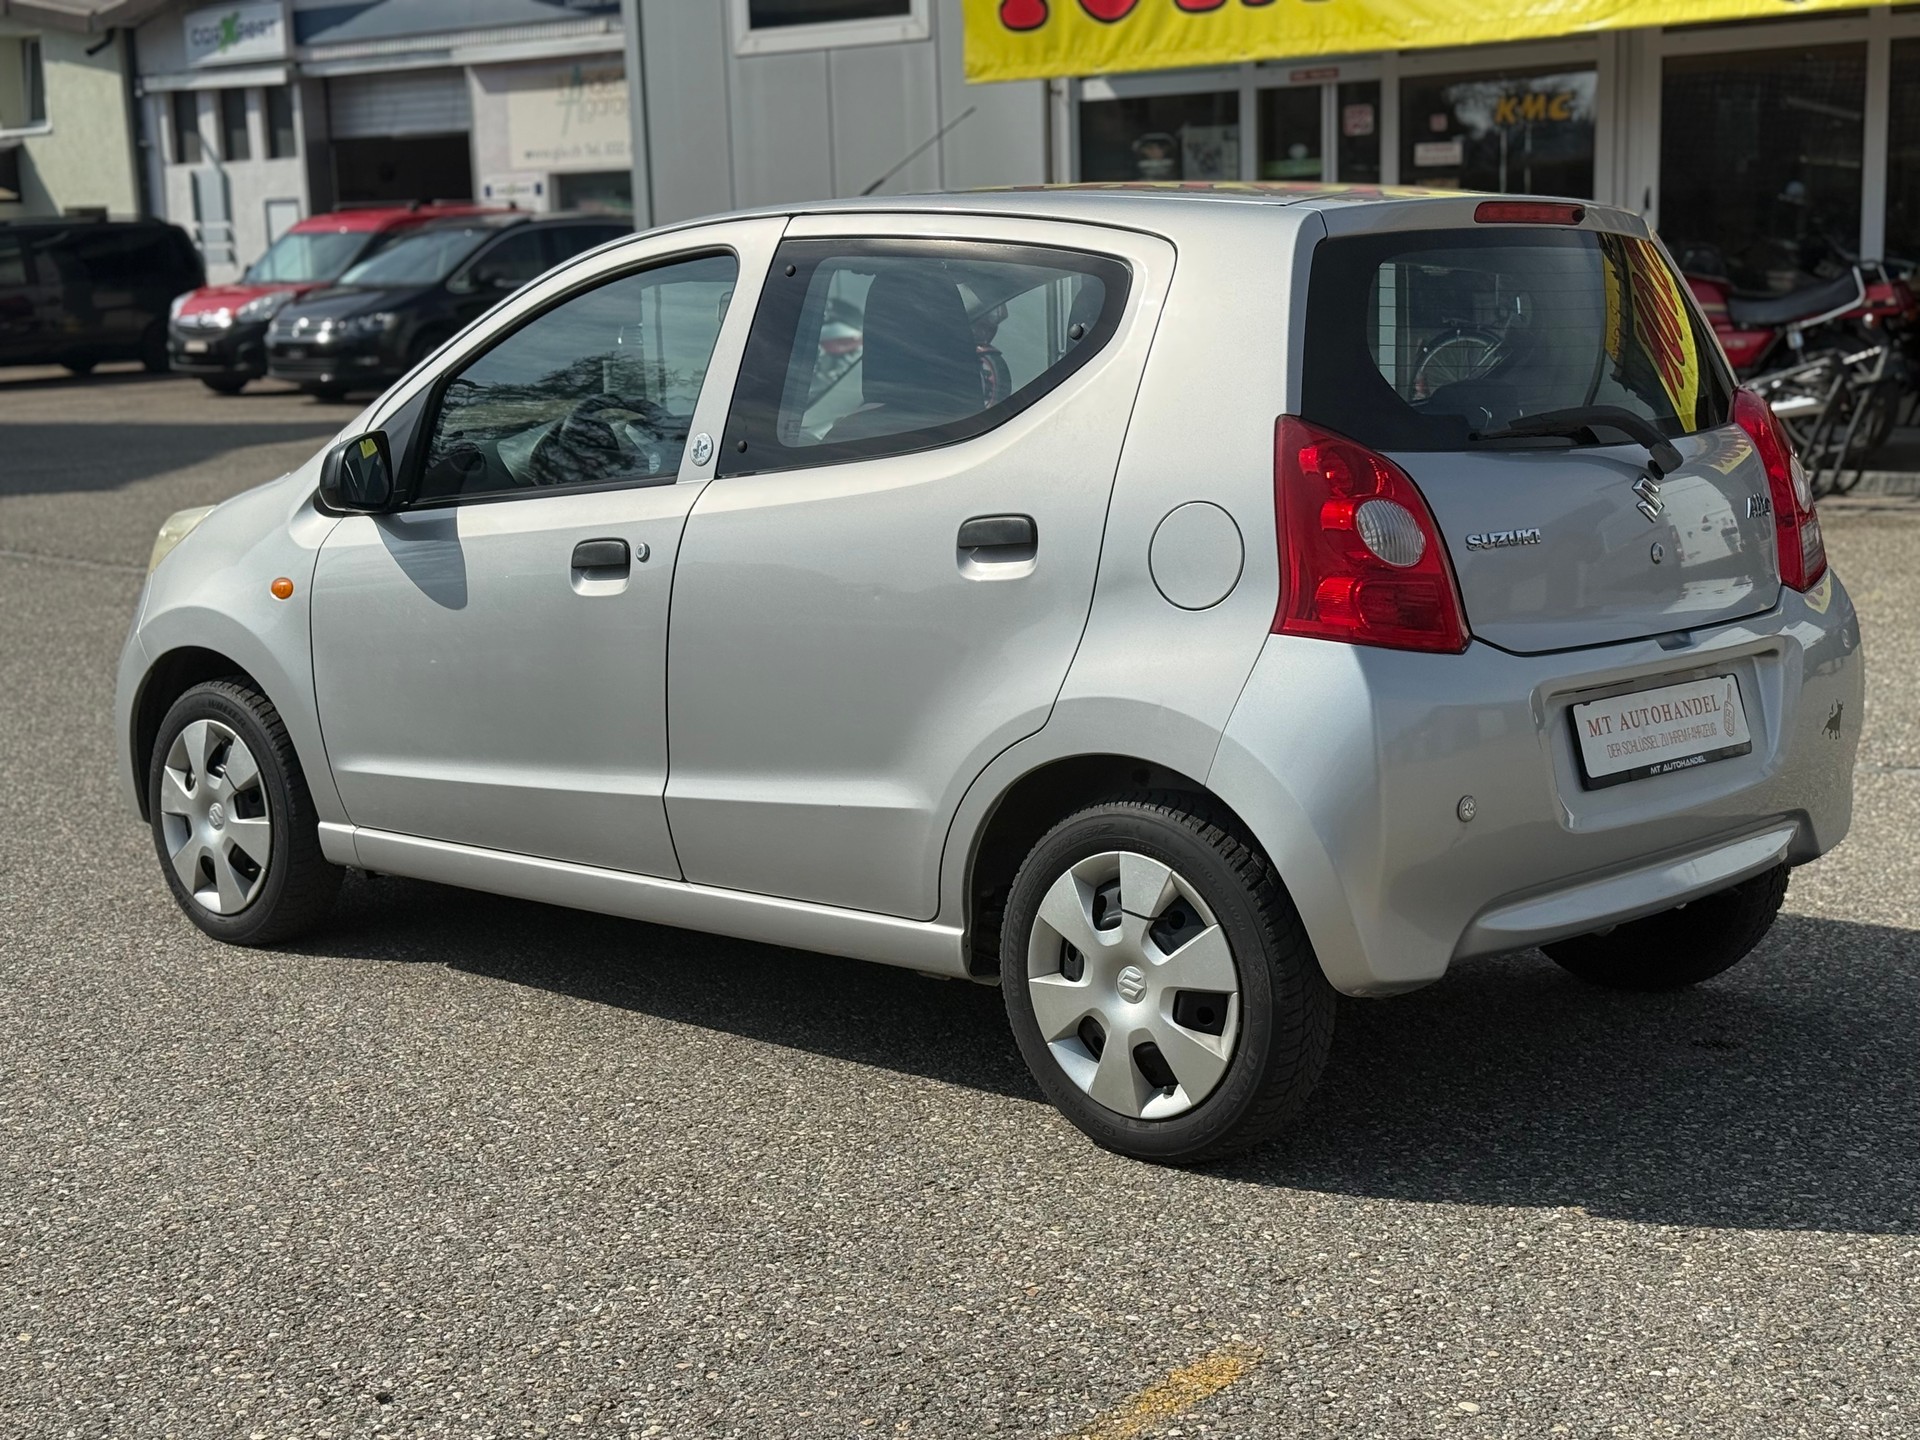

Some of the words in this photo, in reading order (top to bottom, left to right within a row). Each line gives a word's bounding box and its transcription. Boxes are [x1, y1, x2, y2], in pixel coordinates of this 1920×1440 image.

[1495, 92, 1575, 125] KMC
[1465, 528, 1541, 551] SUZUKI
[1586, 715, 1612, 738] MT
[1619, 694, 1721, 732] AUTOHANDEL
[1606, 742, 1623, 759] DER
[1621, 734, 1660, 756] SCHLÜSSEL
[1659, 731, 1672, 747] ZU
[1650, 765, 1661, 775] MT
[1662, 755, 1706, 773] AUTOHANDEL
